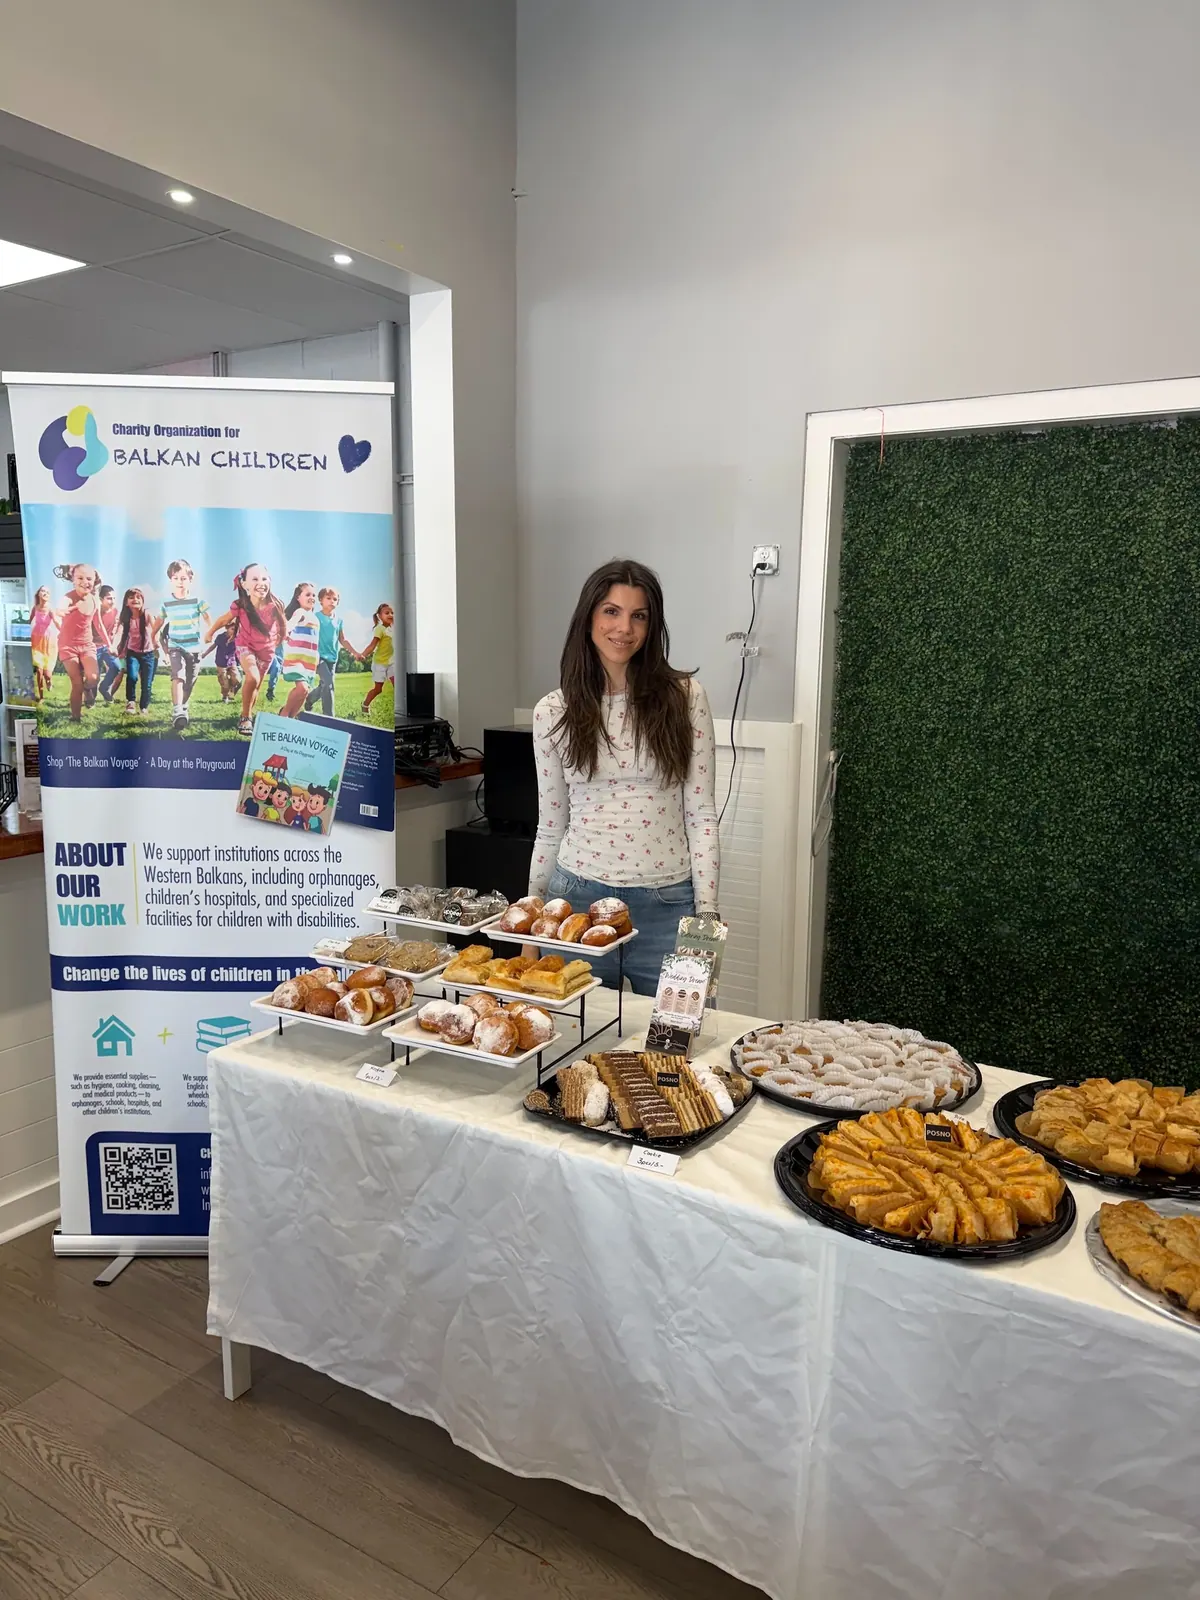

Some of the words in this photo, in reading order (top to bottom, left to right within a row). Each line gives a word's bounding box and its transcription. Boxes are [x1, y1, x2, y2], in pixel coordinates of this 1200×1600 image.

[113, 424, 150, 436] Charity
[154, 424, 221, 437] Organization
[225, 426, 240, 437] for
[114, 448, 200, 466] BALKAN
[211, 451, 327, 471] CHILDREN
[262, 732, 276, 741] THE
[278, 733, 307, 746] BALKAN
[309, 740, 338, 759] VOYAGE
[47, 755, 63, 769] Shop
[84, 757, 108, 767] Balkan
[151, 757, 156, 767] A
[158, 758, 171, 770] Day
[173, 758, 180, 768] at
[182, 758, 193, 768] the
[196, 758, 235, 771] Playground
[55, 842, 126, 867] ABOUT
[143, 842, 163, 860] We
[167, 846, 211, 865] support
[214, 845, 279, 862] institutions
[284, 849, 319, 862] across
[324, 845, 342, 863] the
[56, 874, 100, 897] OUR
[144, 866, 192, 884] Western
[196, 866, 247, 887] Balkans,
[252, 867, 304, 888] including
[308, 868, 380, 890] orphanages,
[204, 889, 260, 909] hospitals,
[265, 889, 287, 906] and
[291, 890, 354, 909] specialized
[57, 904, 126, 926] WORK
[145, 909, 192, 926] facilities
[196, 910, 213, 926] for
[217, 910, 263, 927] children
[267, 910, 292, 927] with
[297, 910, 360, 929] disabilities.
[63, 966, 120, 982] Change
[124, 966, 148, 980] the
[152, 966, 186, 981] lives
[191, 966, 206, 981] of
[210, 966, 272, 982] children
[276, 967, 290, 981] in
[84, 1073, 104, 1081] provide
[92, 1083, 114, 1091] hygiene,
[116, 1082, 137, 1090] cooking,
[138, 1082, 160, 1090] cleaning,
[72, 1100, 104, 1108] orphanages,
[94, 1090, 114, 1098] medical
